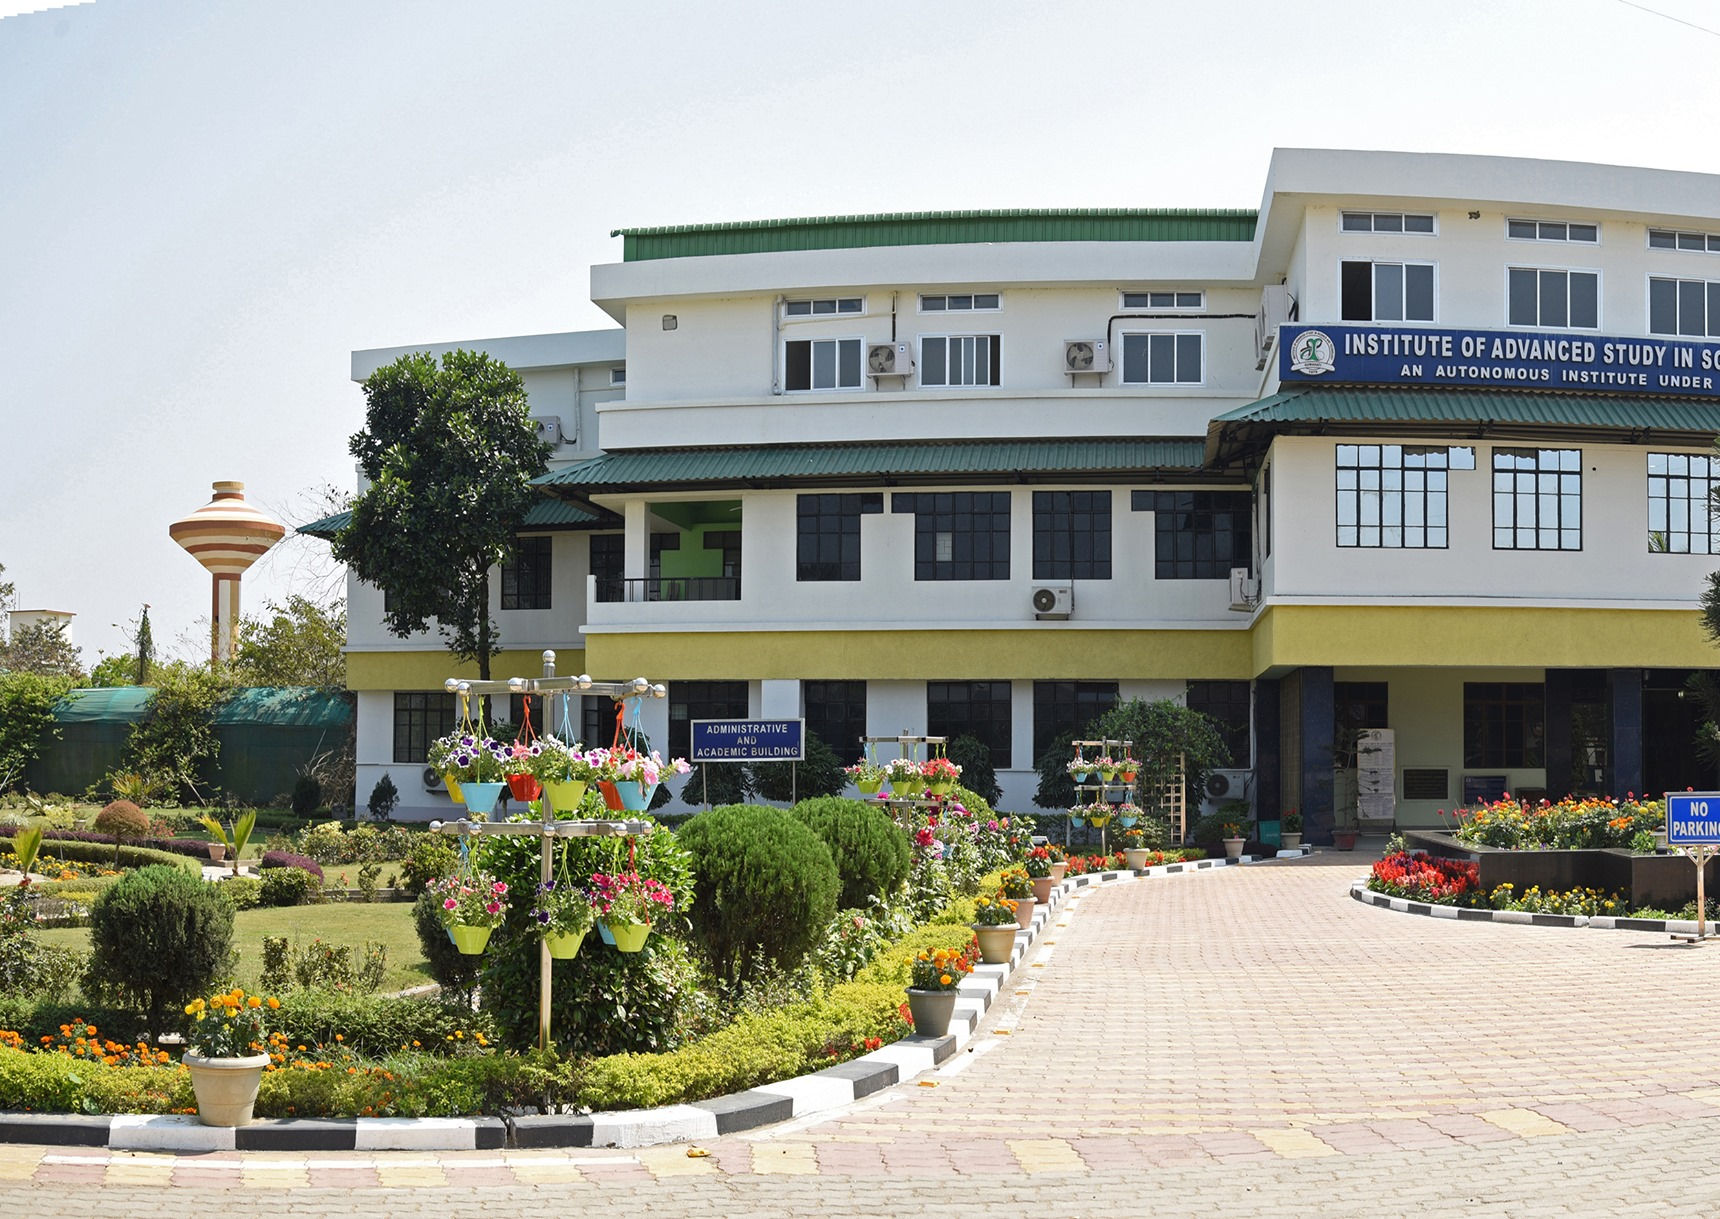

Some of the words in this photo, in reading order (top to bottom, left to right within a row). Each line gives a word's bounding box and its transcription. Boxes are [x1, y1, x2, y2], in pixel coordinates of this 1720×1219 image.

[1345, 333, 1453, 357] INSTITUTE
[1461, 337, 1486, 358] OF
[1491, 338, 1596, 363] ADVANCED
[1603, 343, 1667, 368] STUDY
[1673, 347, 1693, 369] IN
[1401, 364, 1422, 377] AN
[1435, 365, 1550, 381] AUTONOMOUS
[1562, 369, 1648, 386] INSTITUTE
[1659, 374, 1713, 390] UNDER
[706, 724, 788, 734] ADMINISTRATIVE
[736, 736, 757, 745] AND
[697, 747, 748, 757] ACADEMIC
[751, 747, 798, 756] BUILDING
[1690, 801, 1709, 817] NO
